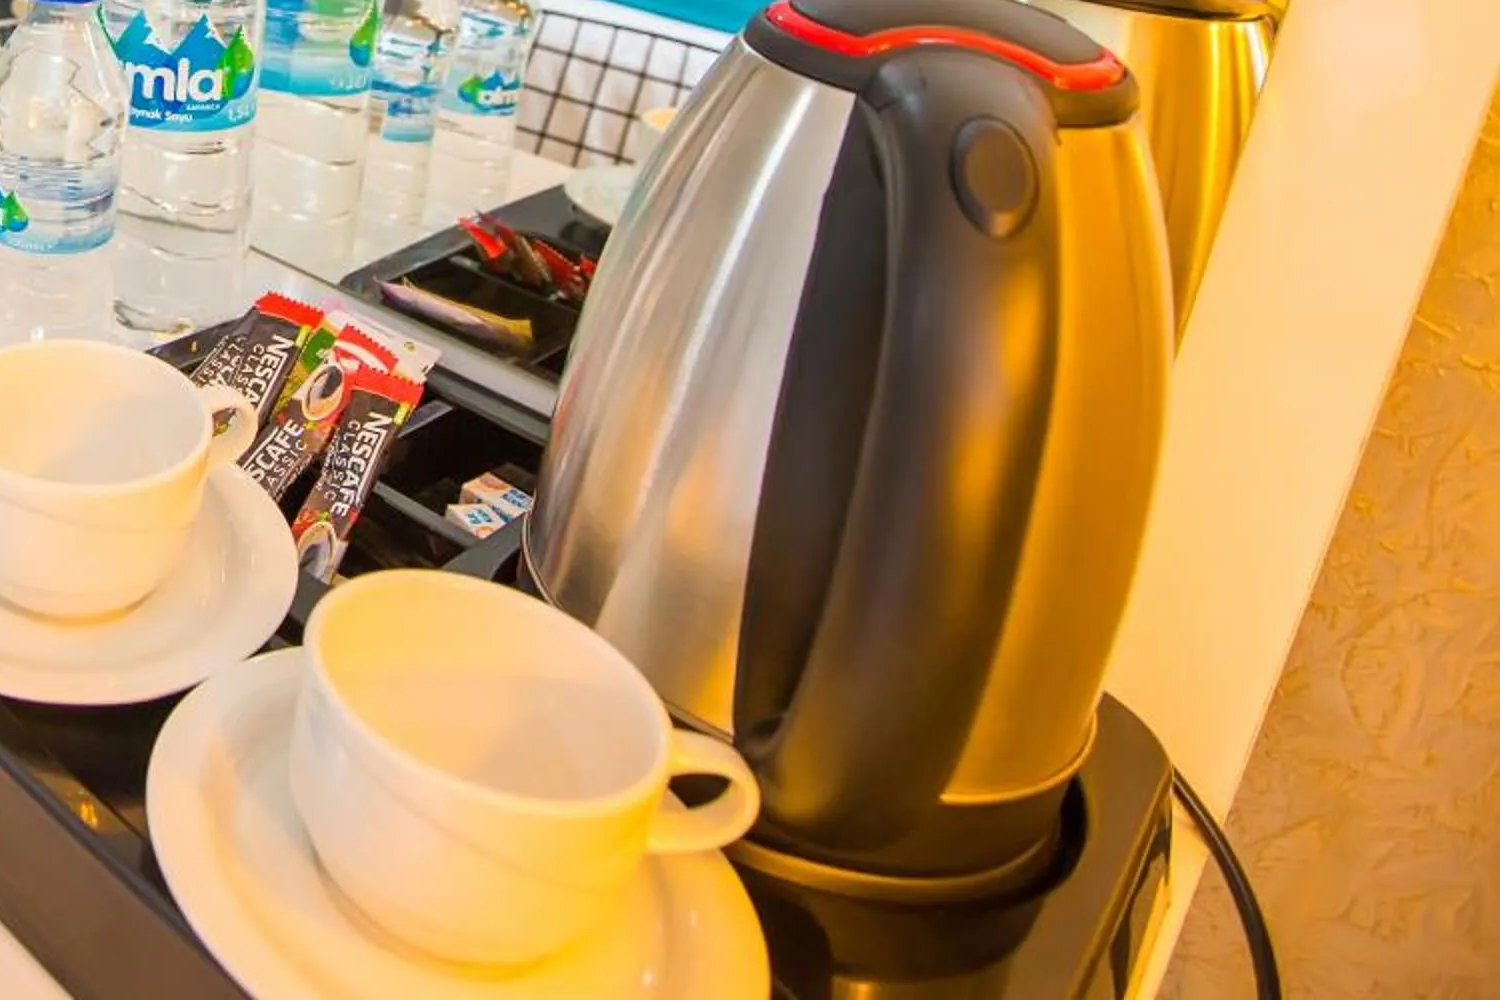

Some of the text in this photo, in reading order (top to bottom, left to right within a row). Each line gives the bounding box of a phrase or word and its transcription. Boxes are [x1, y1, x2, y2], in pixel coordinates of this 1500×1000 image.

[125, 57, 223, 102] mla
[245, 334, 295, 404] NESCA
[250, 419, 304, 481] SCAFE
[265, 439, 307, 486] ASSIC
[323, 419, 361, 501] CLASSIC
